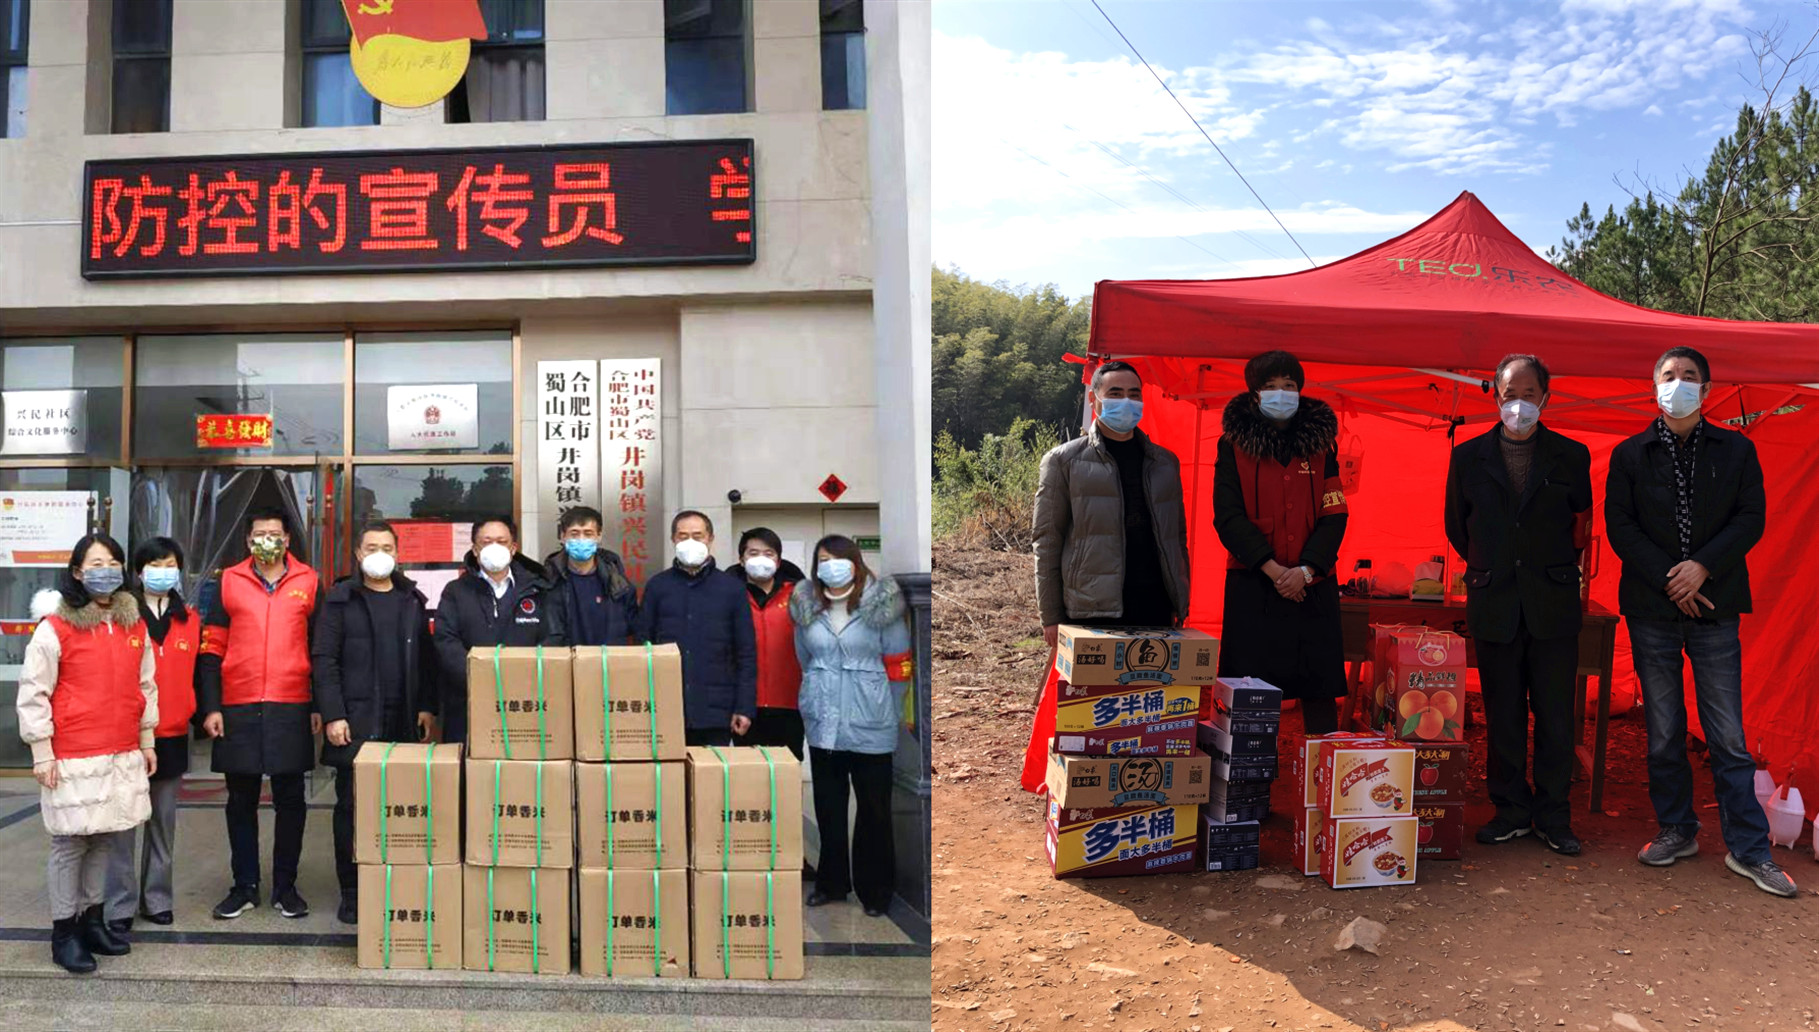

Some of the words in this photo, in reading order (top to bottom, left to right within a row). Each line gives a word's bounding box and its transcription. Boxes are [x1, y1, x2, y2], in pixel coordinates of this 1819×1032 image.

[91, 162, 623, 260] 防控的宣传员
[8, 426, 78, 437] 综合文化服务中心
[17, 407, 70, 420] 兴民社区
[545, 372, 566, 441] 蜀山区
[569, 371, 592, 441] 合肥市
[609, 370, 630, 440] 合肥市蜀山区
[634, 369, 656, 440] 中国共产党
[1093, 689, 1164, 728] 多半桶
[1110, 738, 1139, 754] 多半桶
[1084, 807, 1175, 863] 多半桶
[1118, 839, 1173, 860] 面大多半桶
